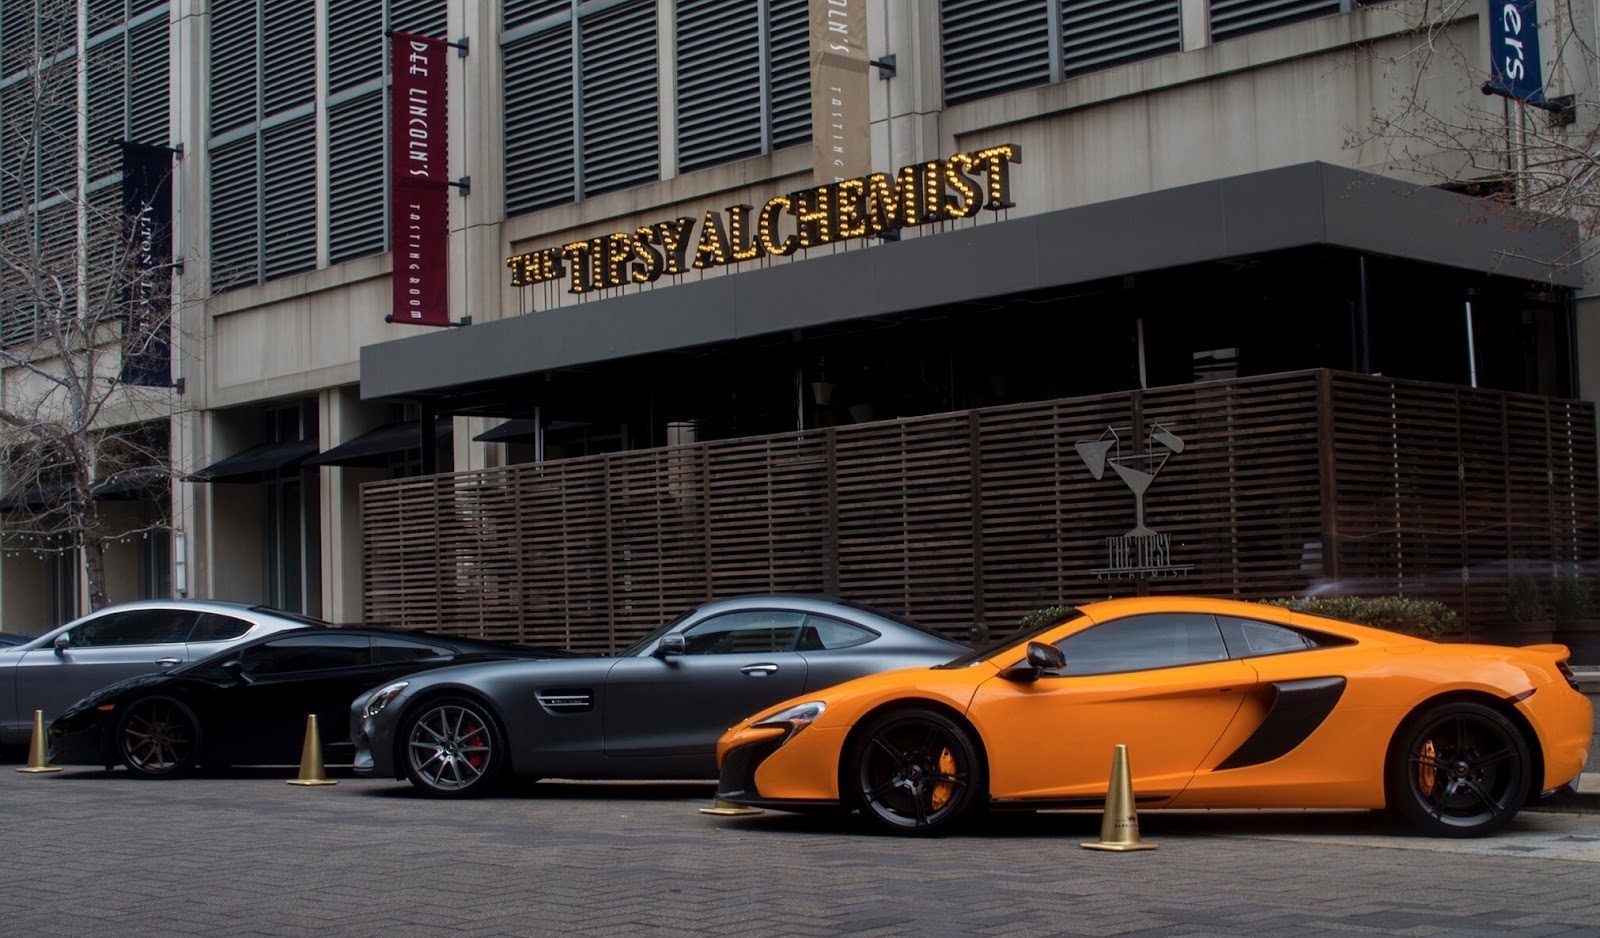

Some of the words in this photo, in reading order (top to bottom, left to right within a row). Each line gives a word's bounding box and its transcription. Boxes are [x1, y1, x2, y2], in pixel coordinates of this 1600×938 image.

[409, 40, 429, 77] DEE
[1503, 3, 1524, 80] ers
[409, 88, 429, 178] LINCOLN'S
[831, 87, 845, 168] TASTING
[140, 200, 154, 265] ALTON
[409, 204, 421, 270] TASTING
[505, 248, 566, 288] THE
[562, 216, 697, 295] TIPSY
[693, 143, 1022, 268] ALCHEMIST
[409, 277, 422, 319] ROOM
[1097, 569, 1188, 580] ALCHEMIST
